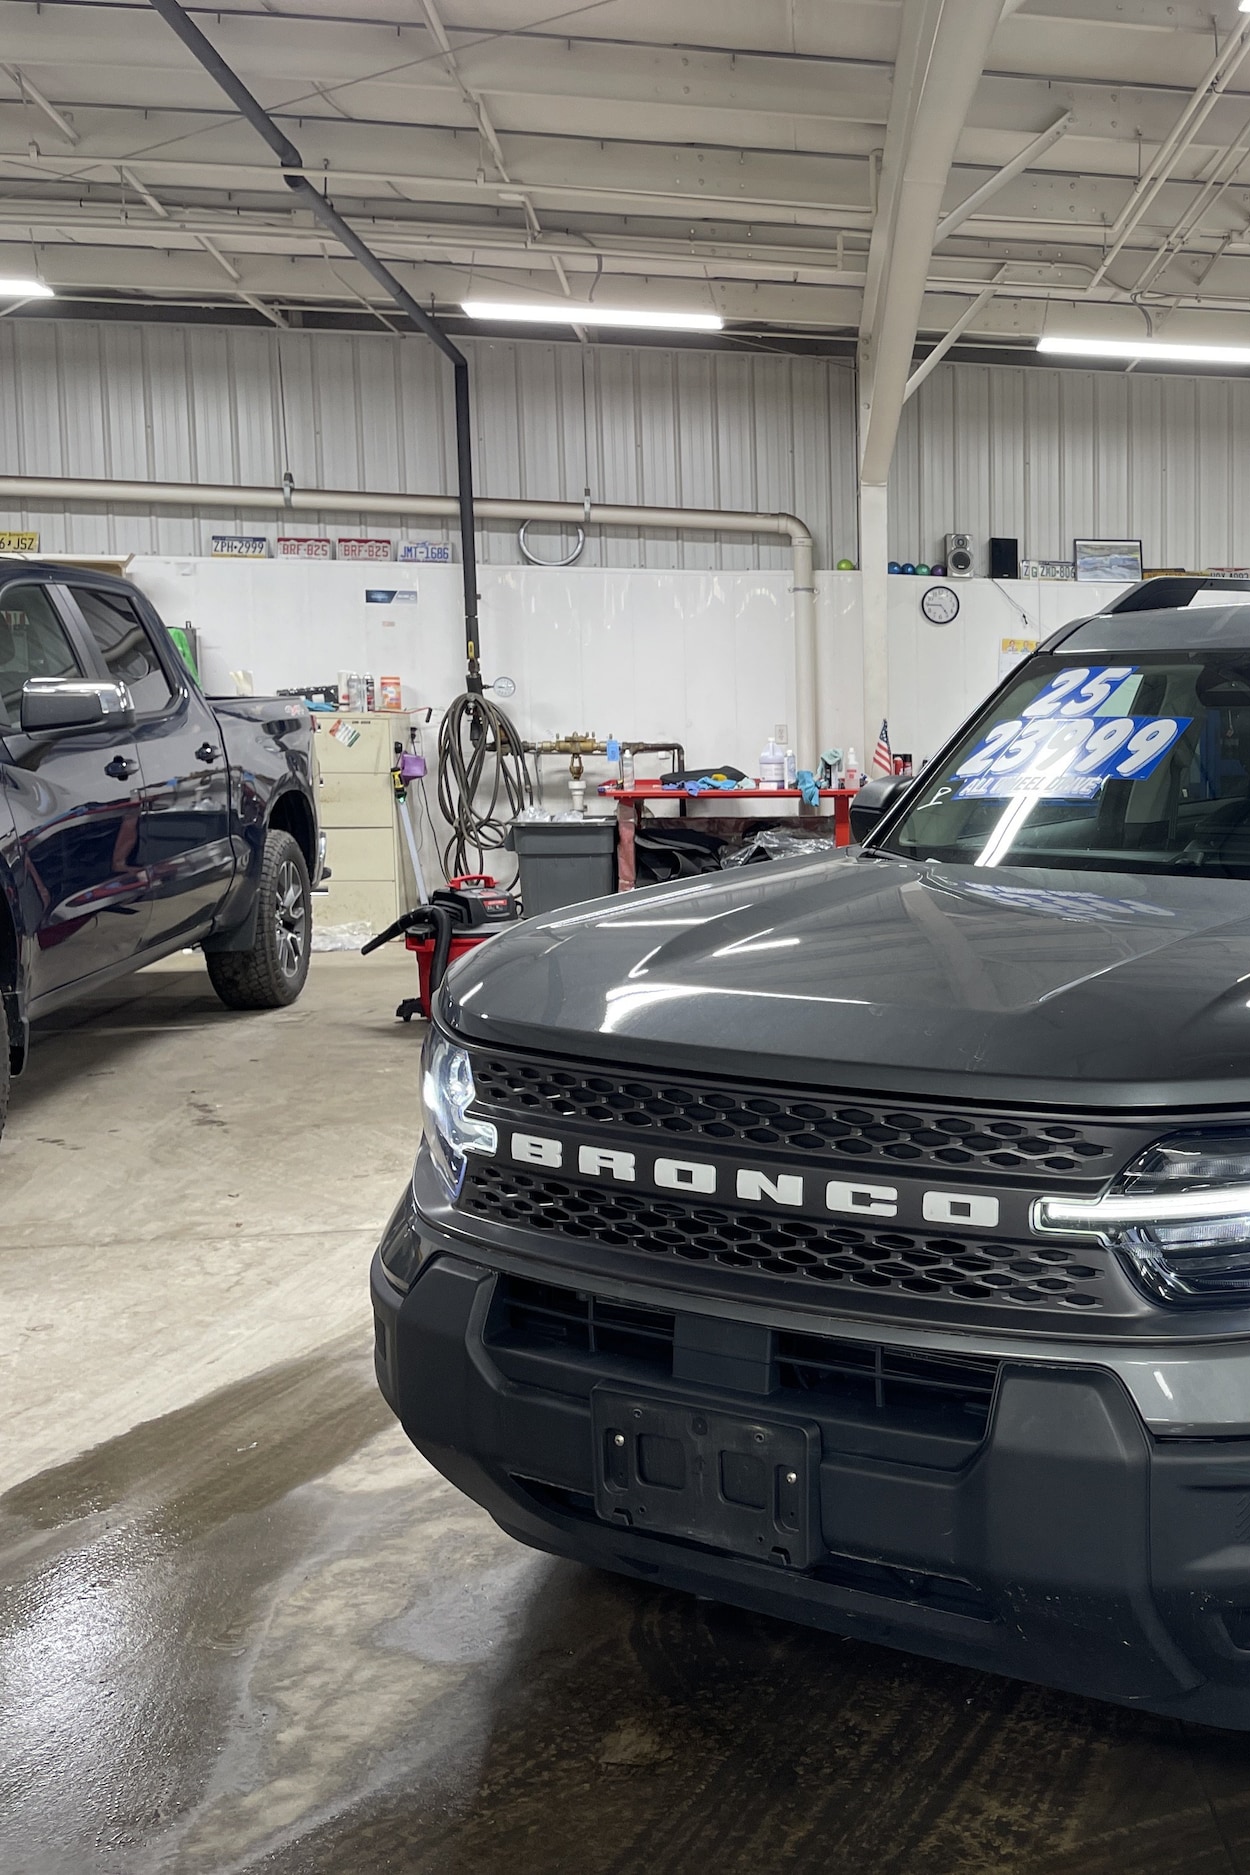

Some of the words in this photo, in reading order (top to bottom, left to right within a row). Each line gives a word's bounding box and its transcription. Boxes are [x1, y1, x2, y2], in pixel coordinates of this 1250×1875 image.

[1021, 667, 1133, 719] 25
[955, 717, 1179, 777] 23999
[511, 1132, 999, 1227] BRONCO
